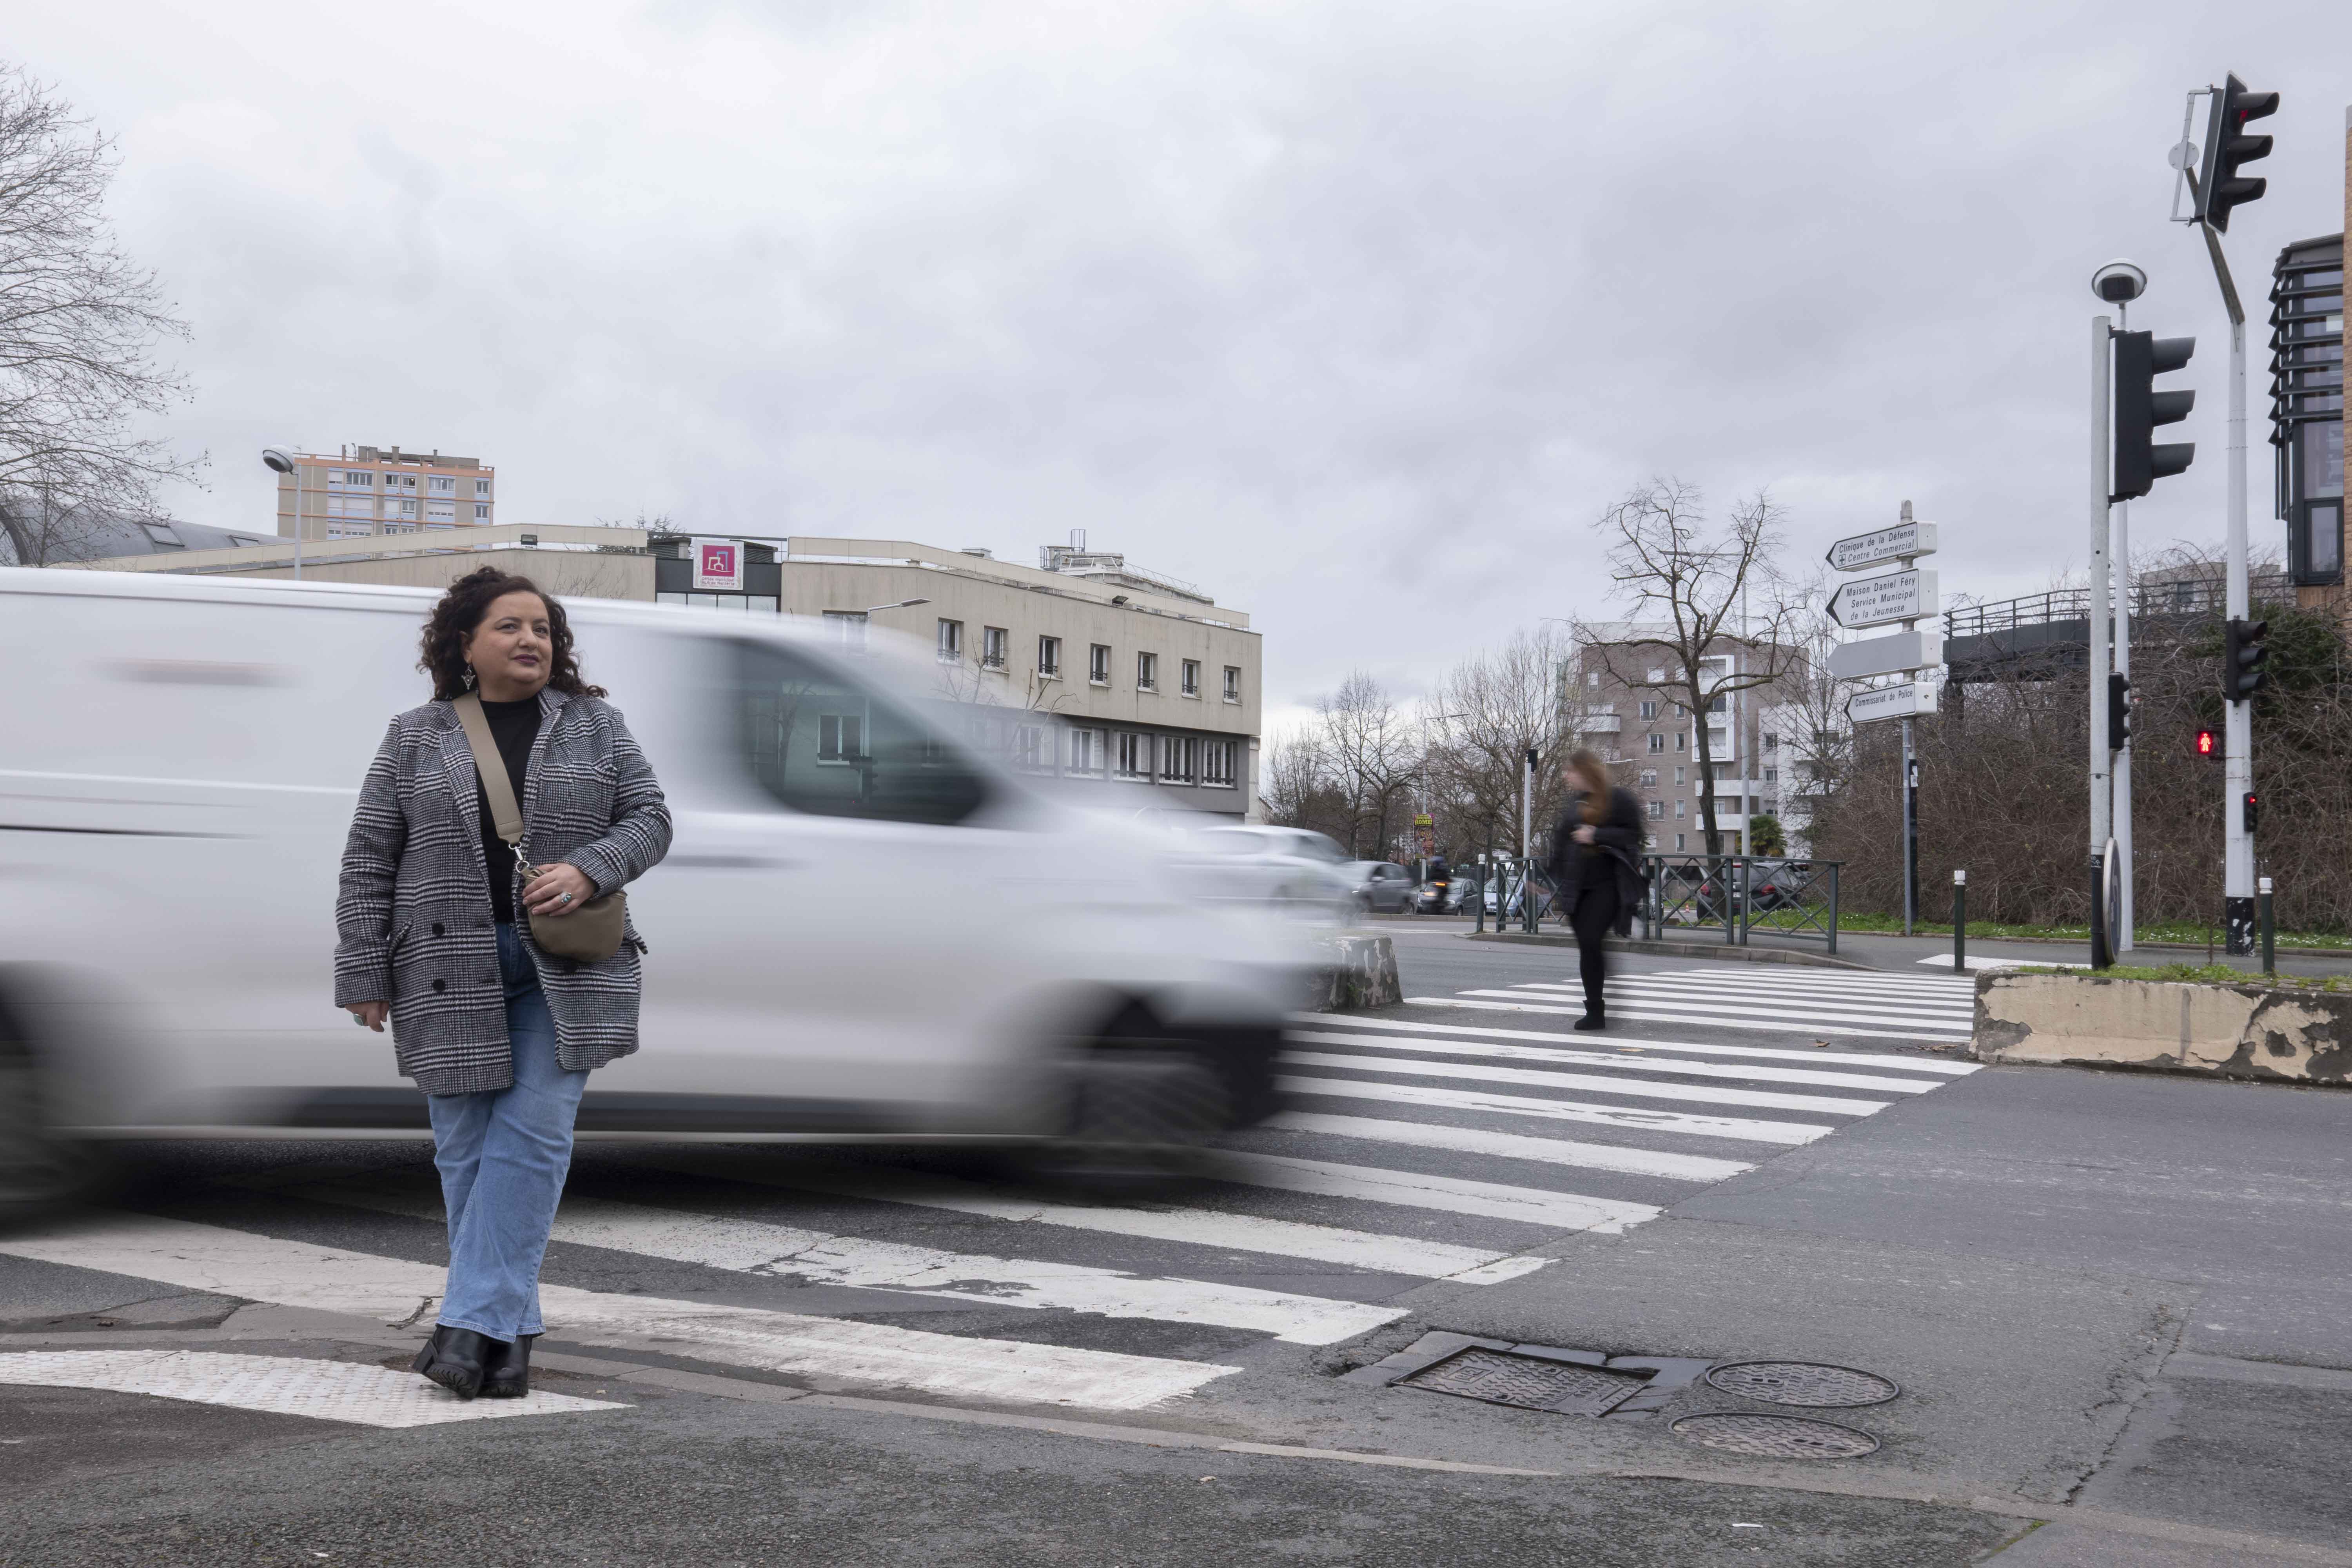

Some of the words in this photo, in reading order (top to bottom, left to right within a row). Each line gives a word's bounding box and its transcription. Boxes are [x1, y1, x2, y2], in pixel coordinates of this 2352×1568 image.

[1839, 542, 1863, 553] Clinique
[1867, 538, 1875, 546] de
[1879, 535, 1884, 544] la
[1889, 530, 1914, 542] Défense
[1848, 551, 1869, 562] Centre
[1874, 539, 1915, 556] Commercial
[1846, 587, 1870, 597] Maison
[1874, 579, 1896, 591] Daniel
[1900, 577, 1916, 587] Féry
[1851, 597, 1876, 608] Service
[1880, 588, 1915, 603] Municipal
[1851, 612, 1858, 621] de
[1862, 610, 1868, 618] la
[1873, 605, 1904, 617] Jeunesse
[1855, 695, 1886, 707] Commissariat
[1889, 692, 1895, 701] de
[1898, 689, 1913, 699] Police
